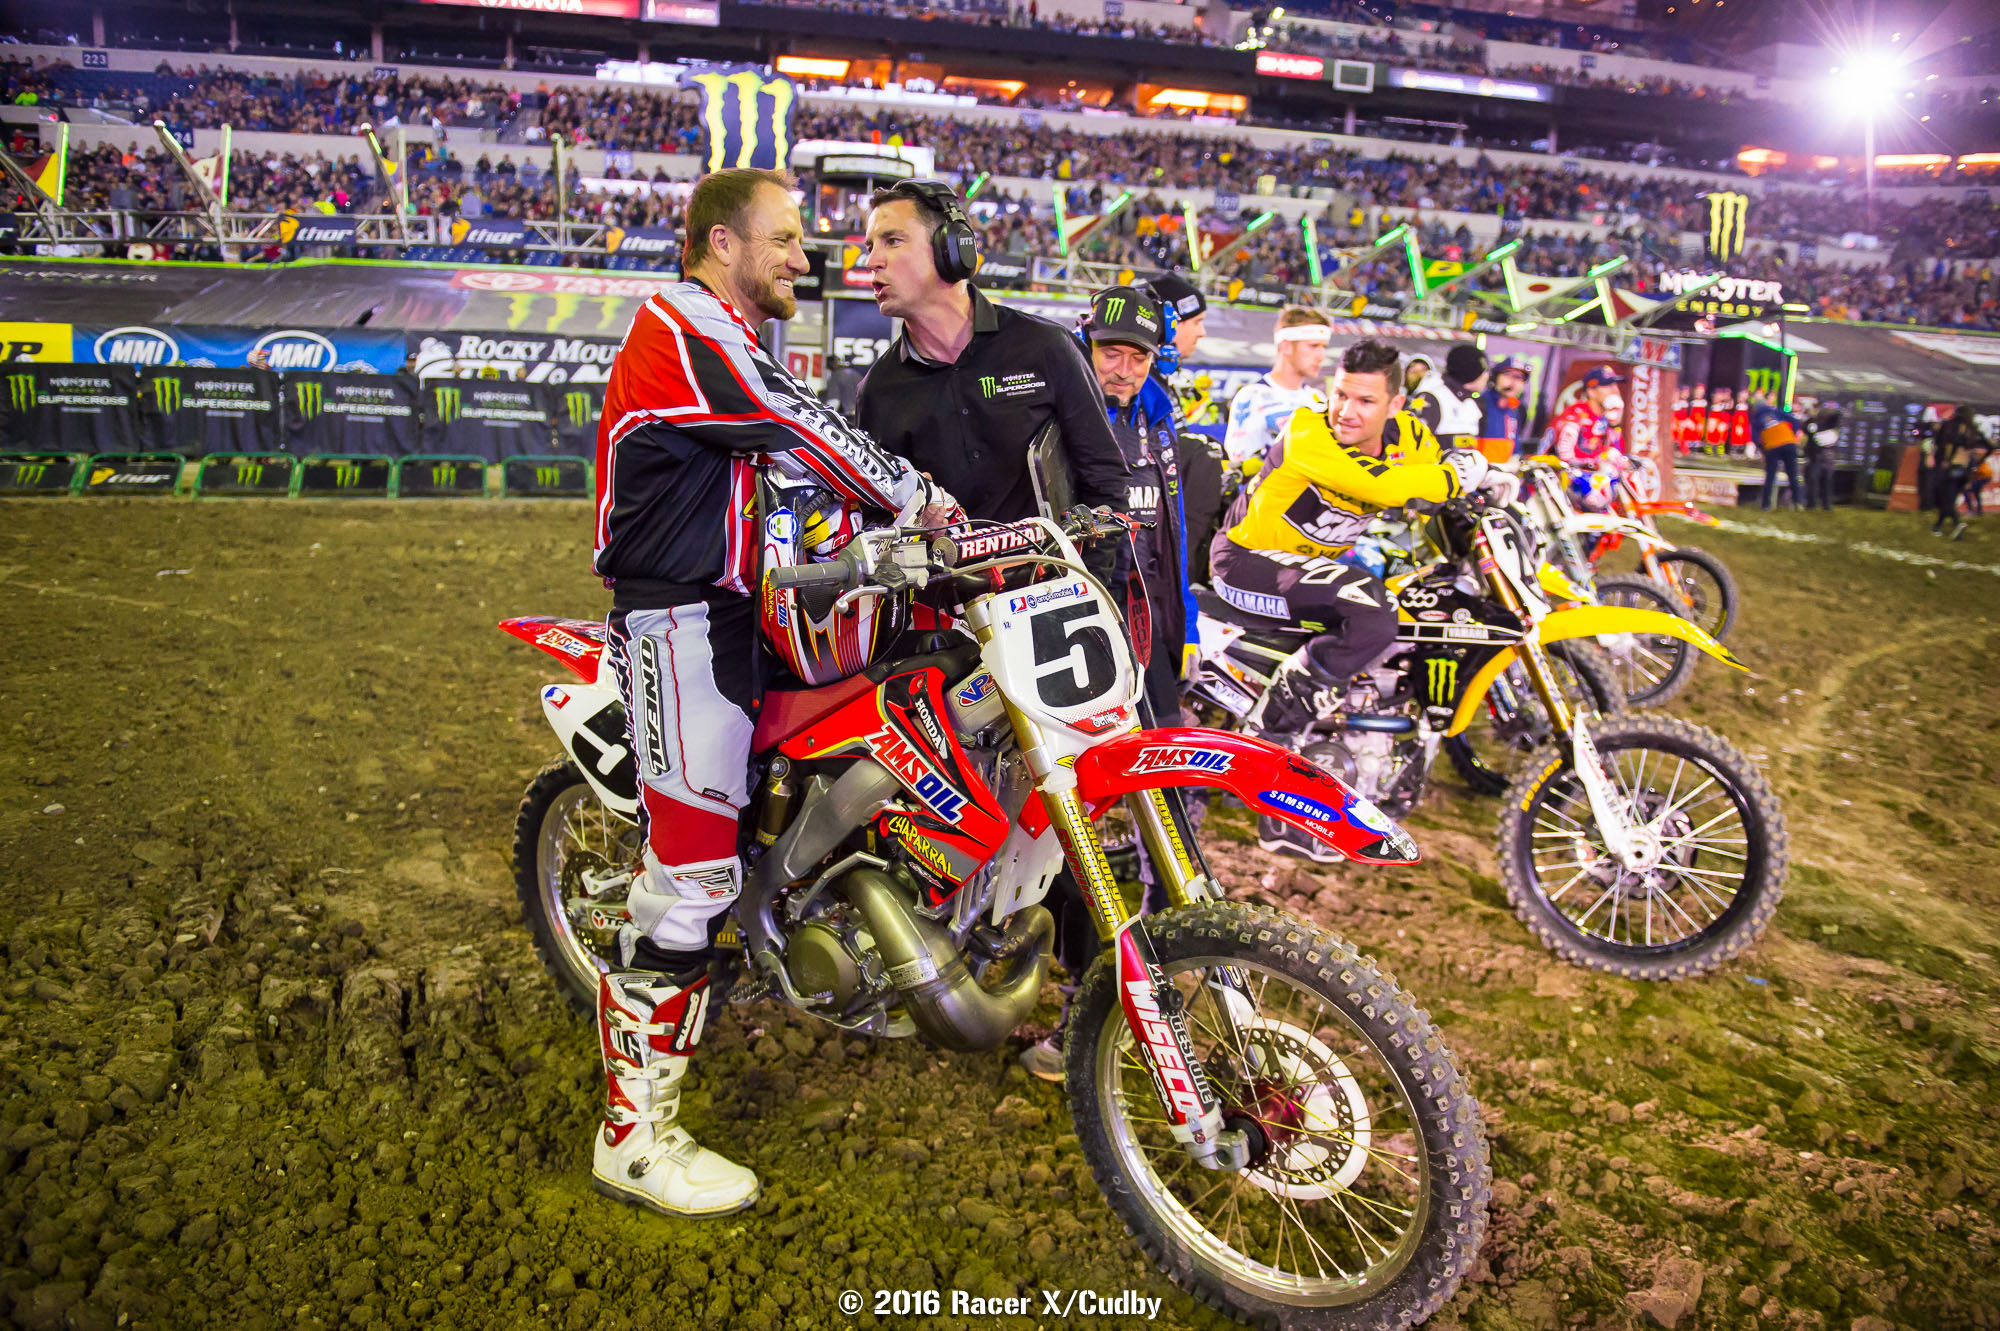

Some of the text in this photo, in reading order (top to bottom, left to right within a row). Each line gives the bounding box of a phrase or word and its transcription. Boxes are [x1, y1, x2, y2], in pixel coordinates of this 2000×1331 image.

[84, 54, 107, 64] 223
[298, 226, 354, 242] thor
[466, 229, 524, 245] thor
[620, 236, 675, 252] thor
[109, 340, 166, 366] MMI
[268, 343, 325, 369] MMI
[455, 335, 548, 362] ROCKY
[996, 381, 1046, 394] SUPERCROSS
[1002, 372, 1036, 383] MONSTER
[793, 406, 895, 498] HONDA
[961, 526, 1048, 560] RENTHAL
[1224, 585, 1288, 617] YAMAHA
[1030, 599, 1117, 708] 5
[914, 698, 947, 755] HONDA
[866, 726, 968, 823] AMSOIL
[1129, 747, 1235, 775] AMSOIL
[1268, 790, 1331, 822] SAMSUNG
[1304, 818, 1336, 839] MOBILE
[888, 815, 962, 883] CHAPARRAL
[1125, 980, 1206, 1119] WISECO
